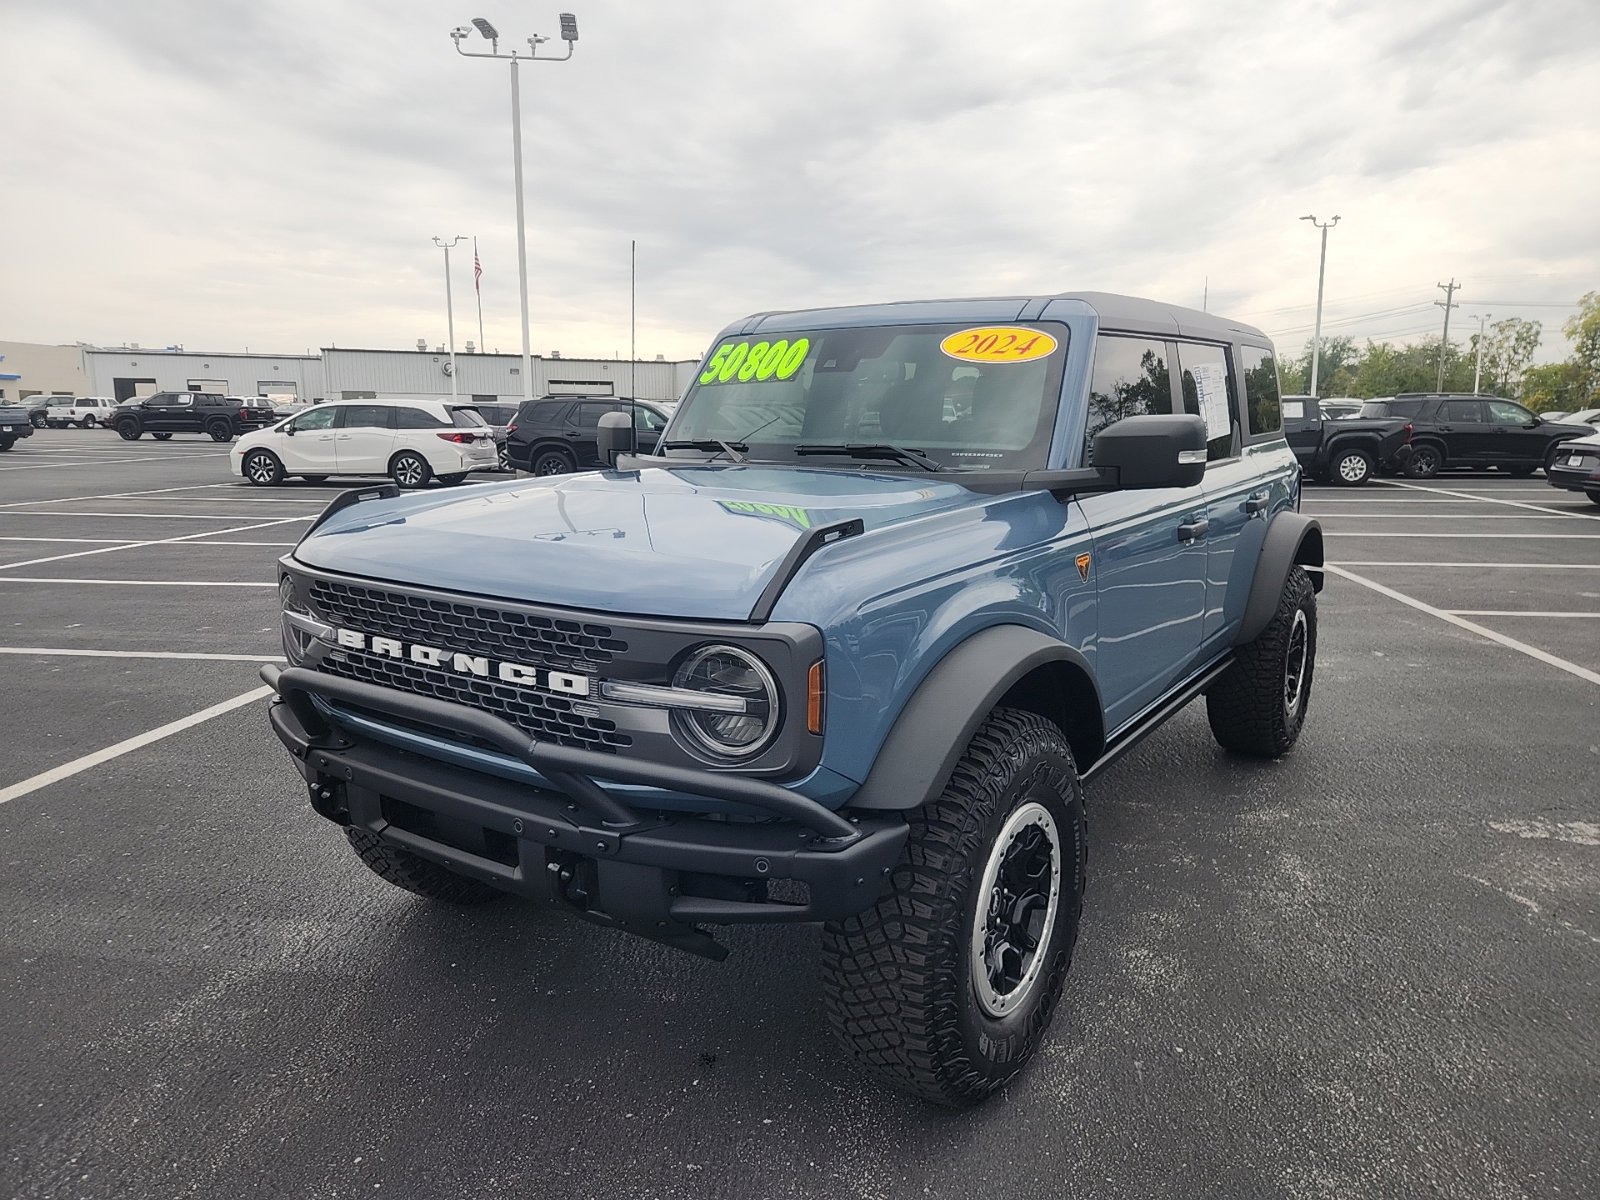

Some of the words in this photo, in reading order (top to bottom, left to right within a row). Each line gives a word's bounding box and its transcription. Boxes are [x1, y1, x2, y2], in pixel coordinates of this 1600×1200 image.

[699, 338, 810, 385] 50800
[954, 334, 1041, 355] 2024
[337, 628, 590, 696] BRONCO
